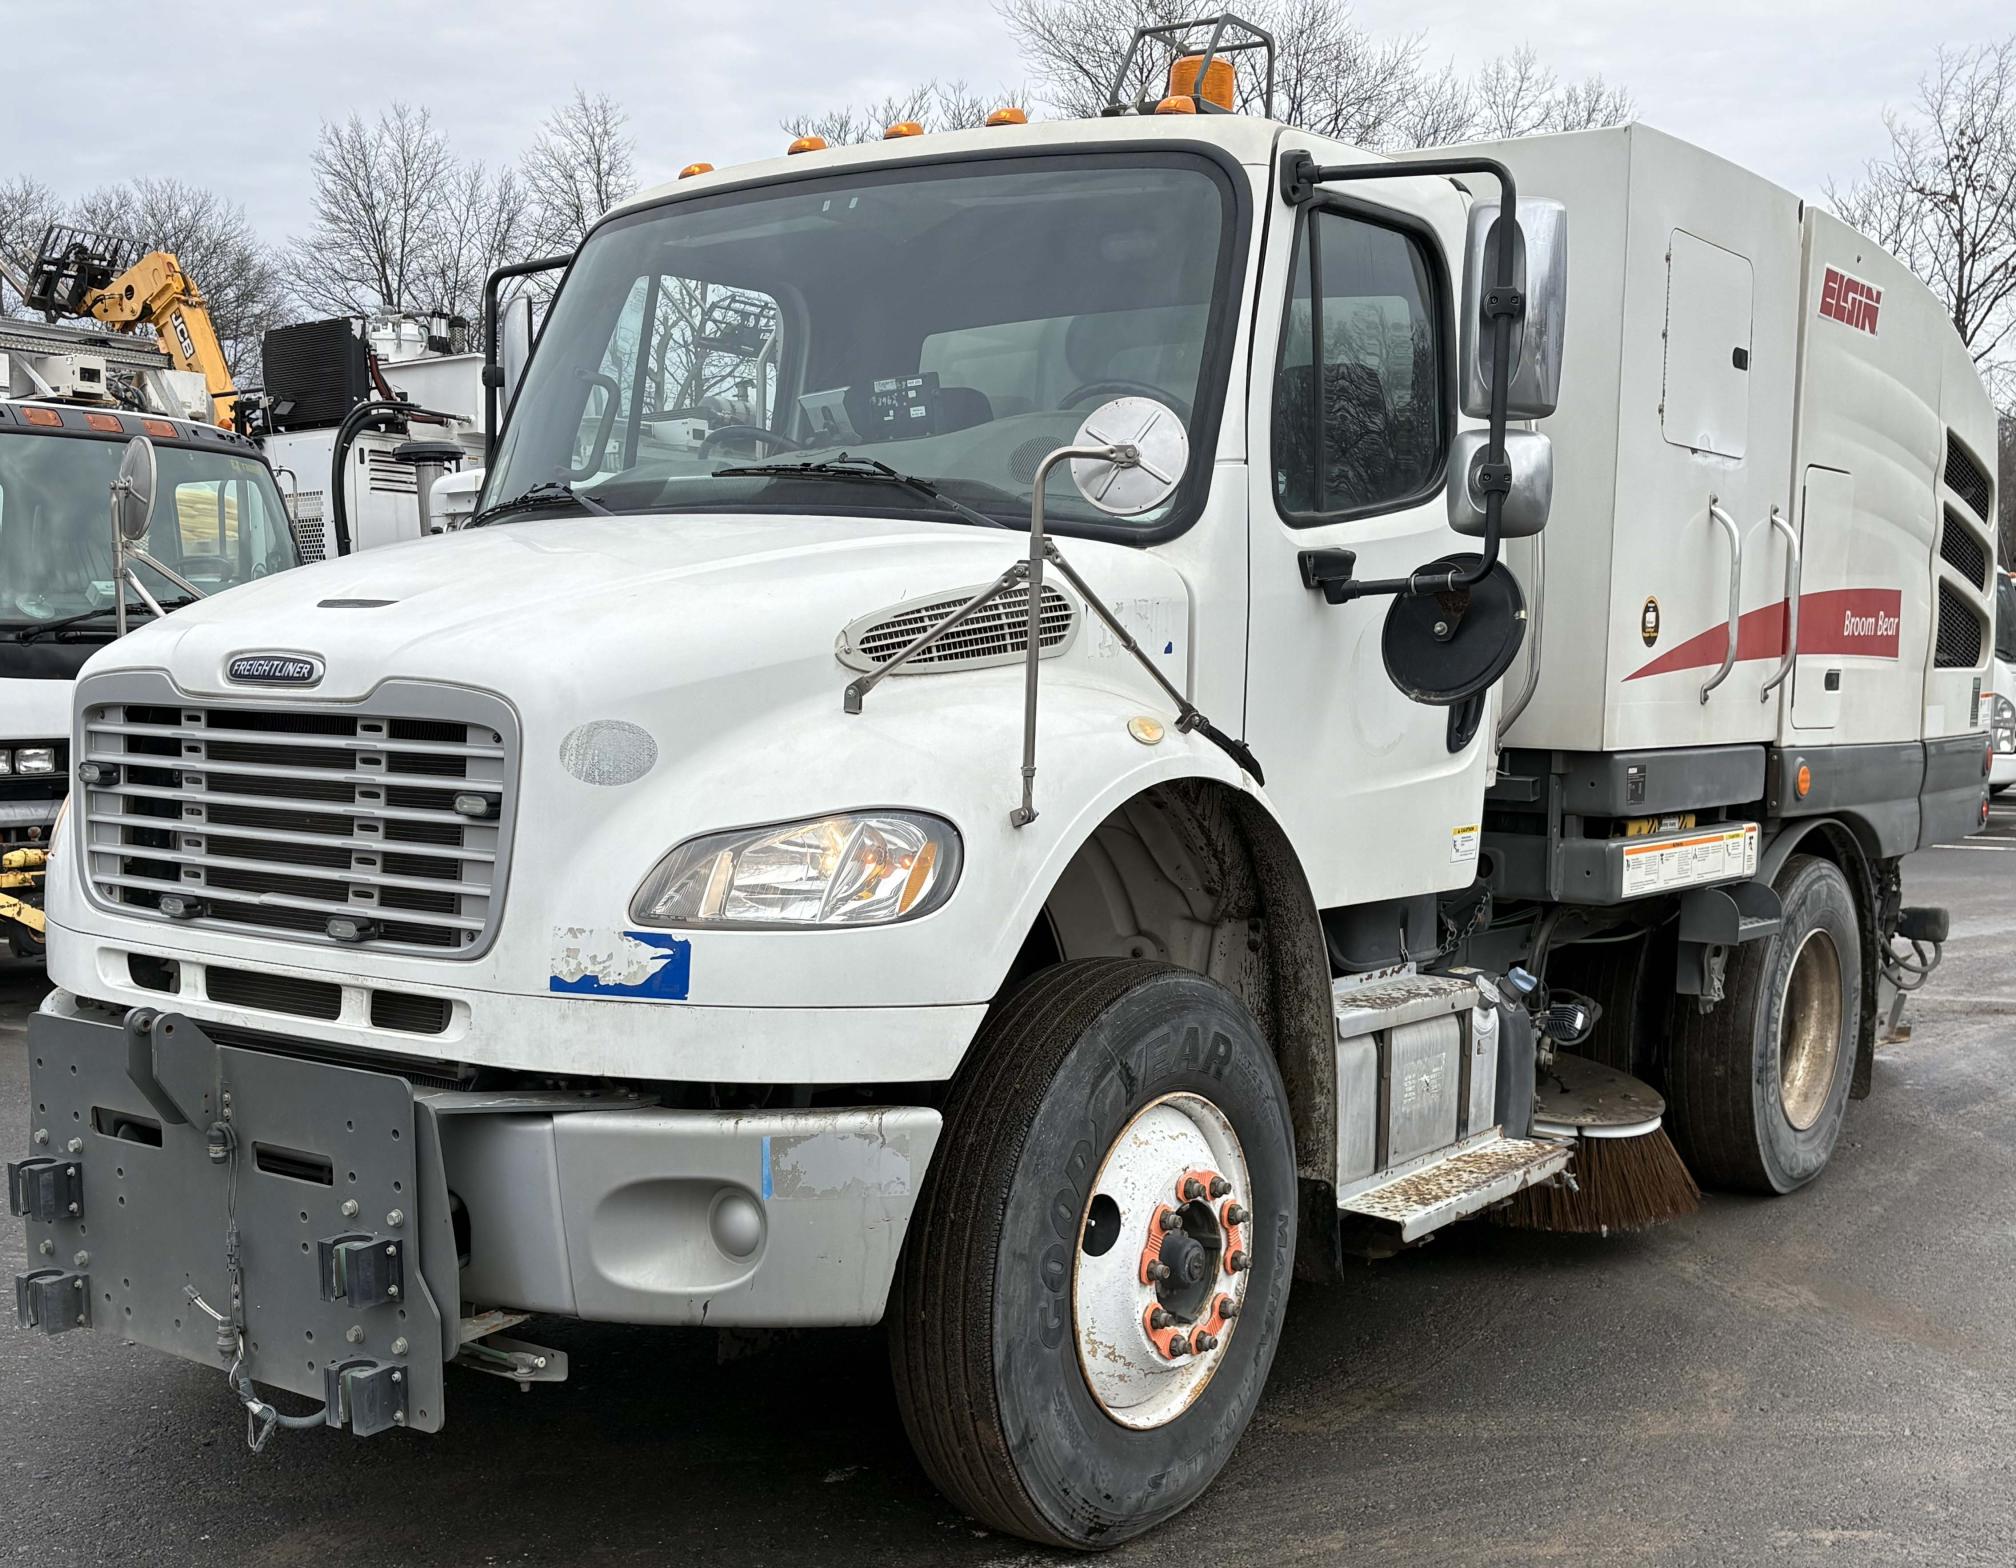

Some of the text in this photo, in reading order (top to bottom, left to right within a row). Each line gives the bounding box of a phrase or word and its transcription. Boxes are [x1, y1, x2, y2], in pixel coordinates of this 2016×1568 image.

[1819, 267, 1882, 336] ELGIN
[171, 308, 196, 358] JCB
[1844, 610, 1899, 636] Broom Bear
[232, 659, 311, 678] FREIGHTLINER
